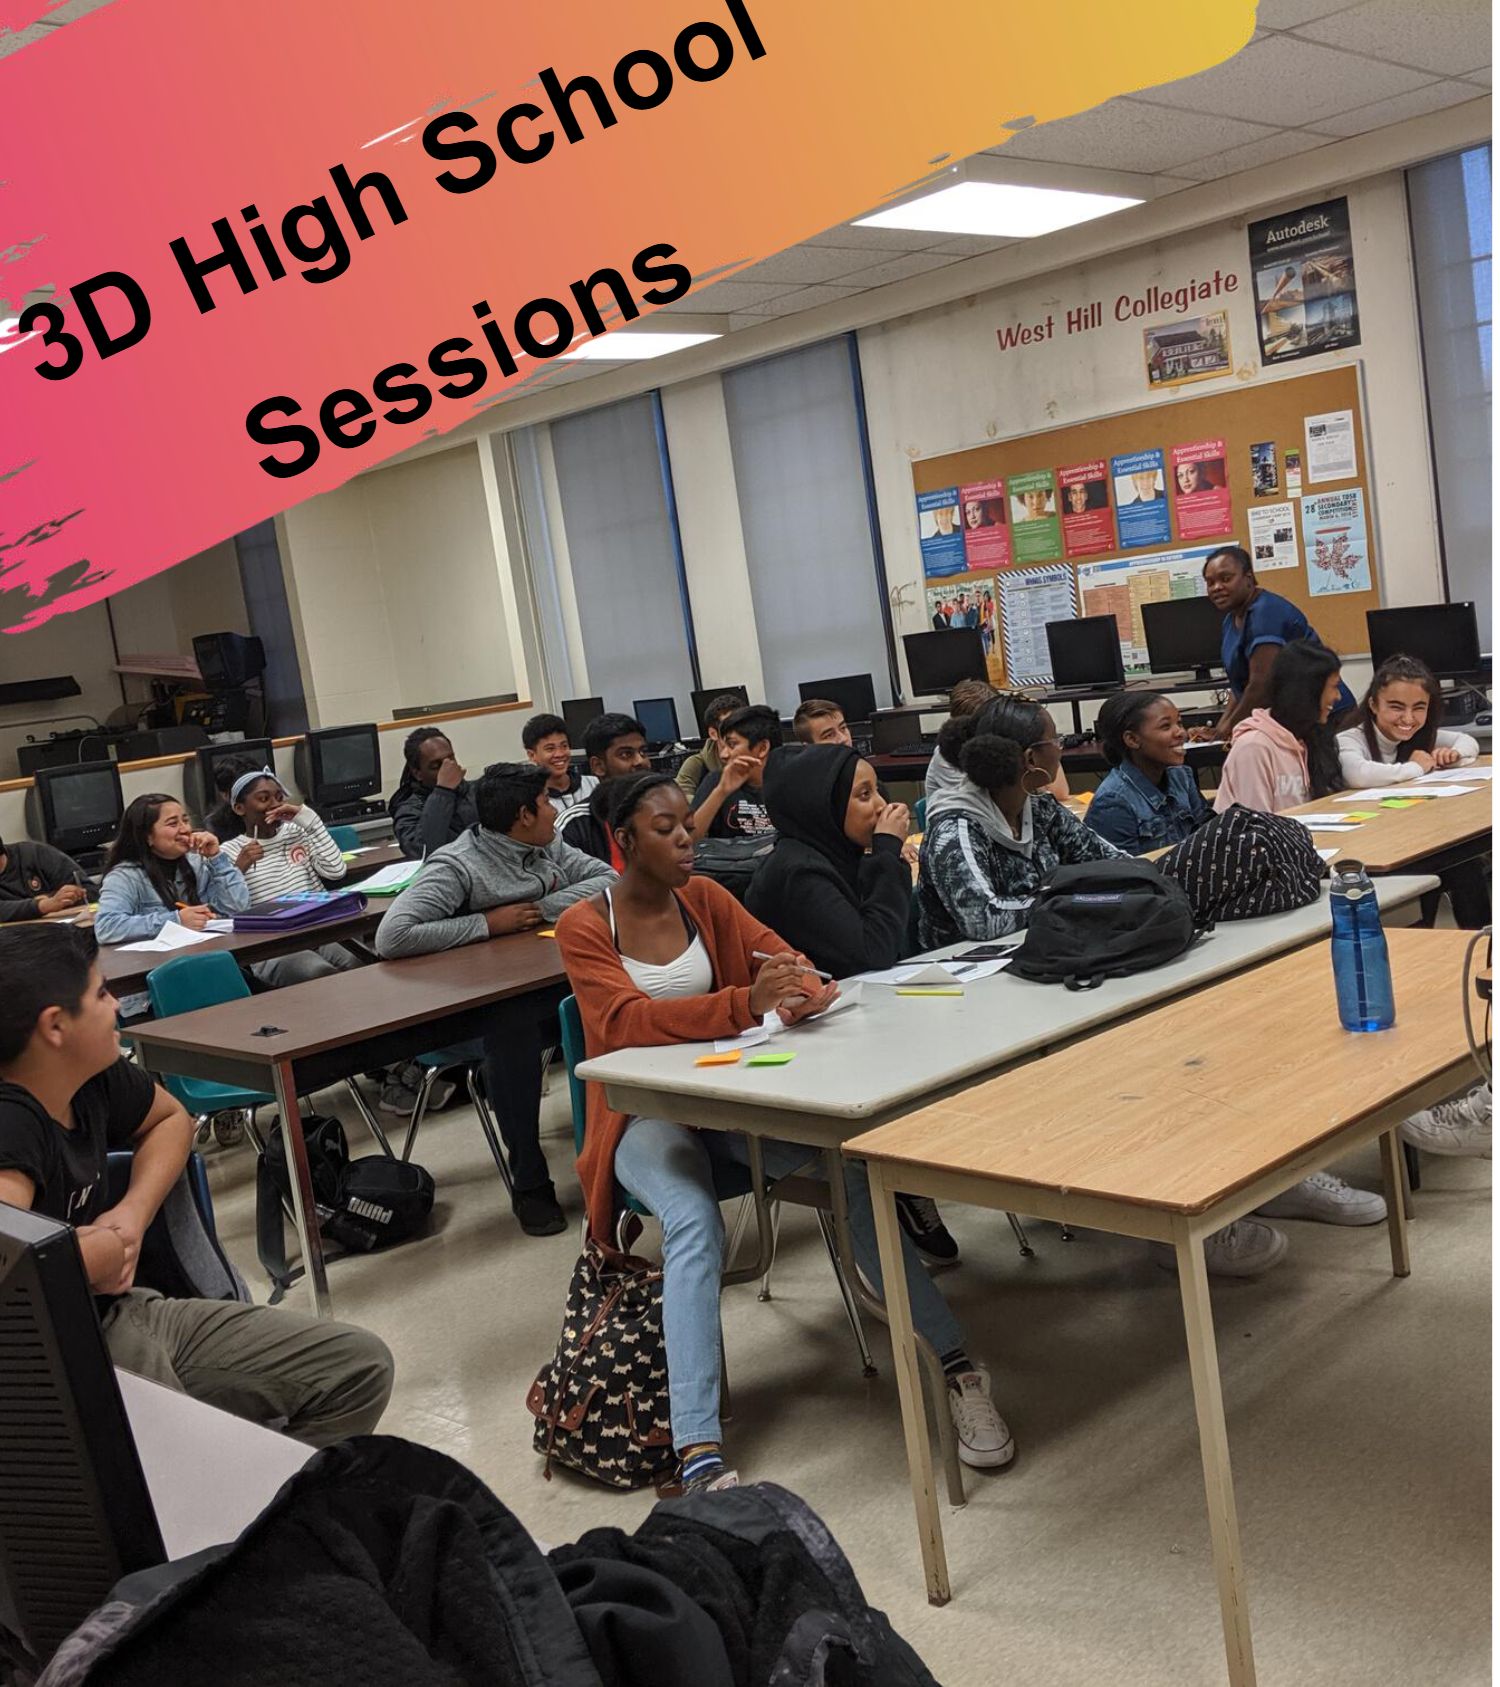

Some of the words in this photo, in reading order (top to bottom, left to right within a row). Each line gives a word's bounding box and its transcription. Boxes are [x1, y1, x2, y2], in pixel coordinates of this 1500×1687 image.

[1266, 215, 1329, 244] Autodesk
[997, 316, 1055, 351] West
[1066, 302, 1102, 335] Hill
[1115, 269, 1240, 322] Collegiate
